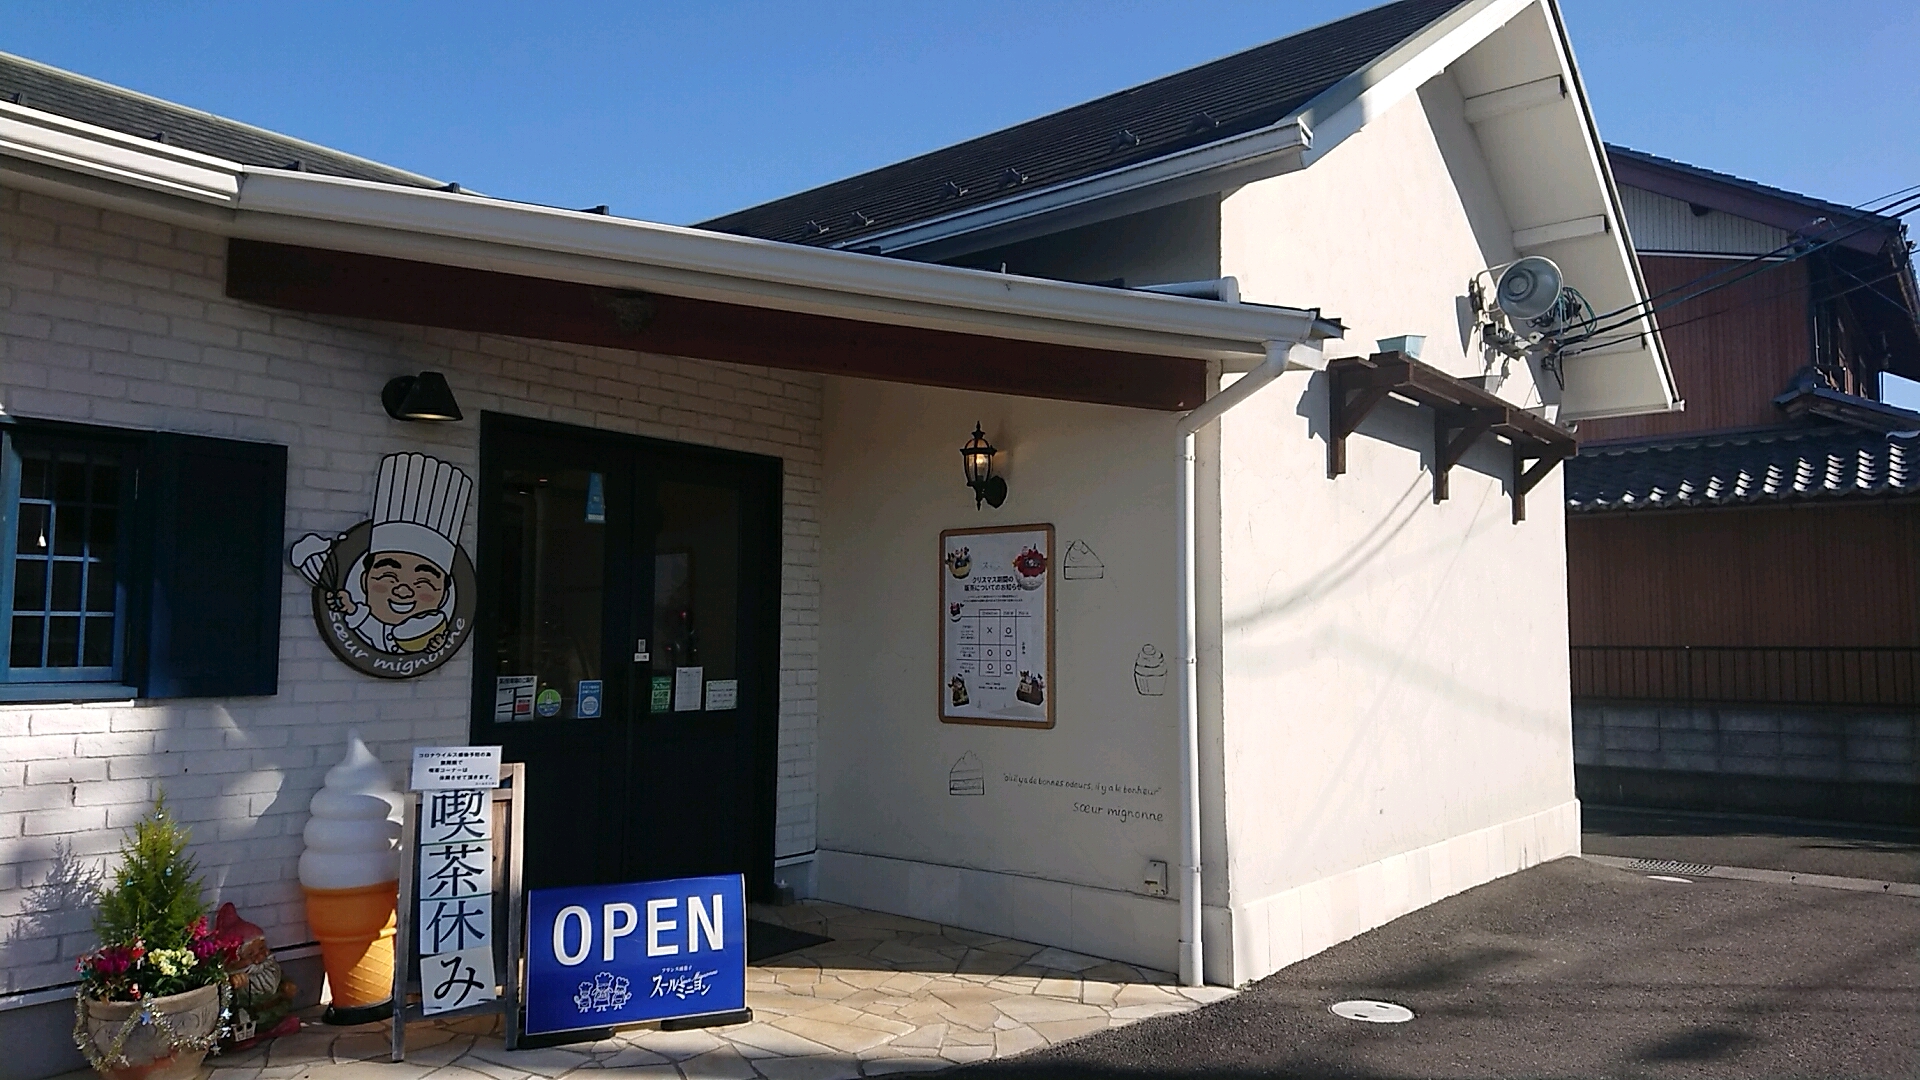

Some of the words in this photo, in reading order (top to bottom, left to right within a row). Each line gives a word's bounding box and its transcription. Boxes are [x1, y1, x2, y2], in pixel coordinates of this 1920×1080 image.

[1107, 806, 1163, 823] mignonne
[427, 789, 485, 1006] 喫茶休み
[553, 894, 724, 966] OPEN
